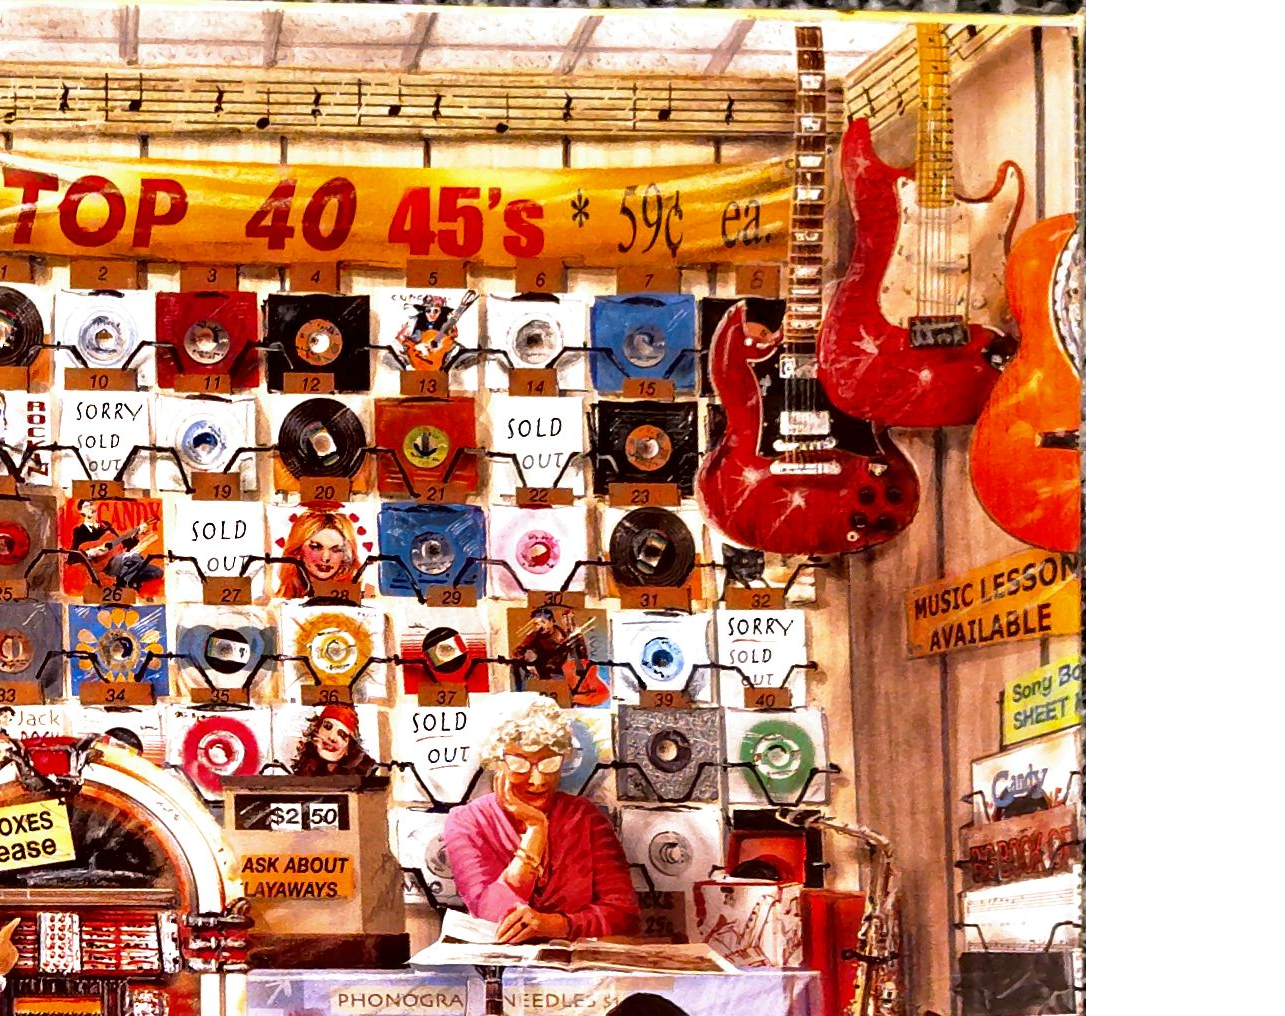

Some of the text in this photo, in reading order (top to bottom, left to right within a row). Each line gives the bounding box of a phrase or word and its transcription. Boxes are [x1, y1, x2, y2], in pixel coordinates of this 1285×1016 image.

[3, 167, 189, 249] TOP
[245, 176, 358, 252] 40
[389, 186, 545, 259] 45's
[617, 182, 685, 258] 59¢
[720, 196, 775, 249] ea.
[97, 264, 108, 281] 2
[310, 267, 321, 285] 4
[428, 271, 439, 286] 5
[535, 271, 546, 288] 6
[645, 273, 655, 288] 7
[90, 373, 110, 390] 10
[204, 375, 223, 391] 11
[302, 376, 321, 393] 12
[419, 378, 438, 394] 13
[526, 379, 545, 395] 14
[638, 381, 657, 397] 15
[75, 401, 144, 423] SORRY
[508, 417, 563, 440] SOLD
[76, 433, 120, 451] SOLD
[89, 458, 121, 474] OUT
[522, 452, 566, 472] OUT
[90, 483, 109, 499] 18
[213, 483, 232, 500] 19
[315, 484, 336, 501] 20
[427, 486, 446, 502] 21
[529, 488, 549, 503] 22
[631, 488, 650, 505] 23
[95, 500, 163, 533] CANDY
[191, 519, 248, 543] SOLD
[207, 555, 248, 573] OUT
[103, 587, 122, 602] 26
[915, 552, 1080, 621] MUSIC LESSON
[222, 588, 242, 603] 27
[442, 590, 462, 606] 29
[640, 592, 658, 608] 31
[752, 594, 771, 609] 32
[728, 616, 794, 638] SORRY
[929, 602, 1053, 652] AVAILABLE
[730, 648, 772, 664] SOLD
[742, 672, 775, 689] OUT
[105, 687, 126, 702] 34
[320, 689, 339, 704] 36
[436, 690, 456, 706] 37
[655, 692, 673, 707] 39
[755, 692, 775, 707] 40
[17, 708, 60, 727] Jack
[1012, 696, 1071, 730] SHEET
[413, 712, 467, 734] SOLD
[428, 746, 470, 764] OUT
[270, 807, 338, 827] $2 50
[241, 856, 349, 875] ASK ABOUT
[243, 881, 338, 899] LAYAWAYS
